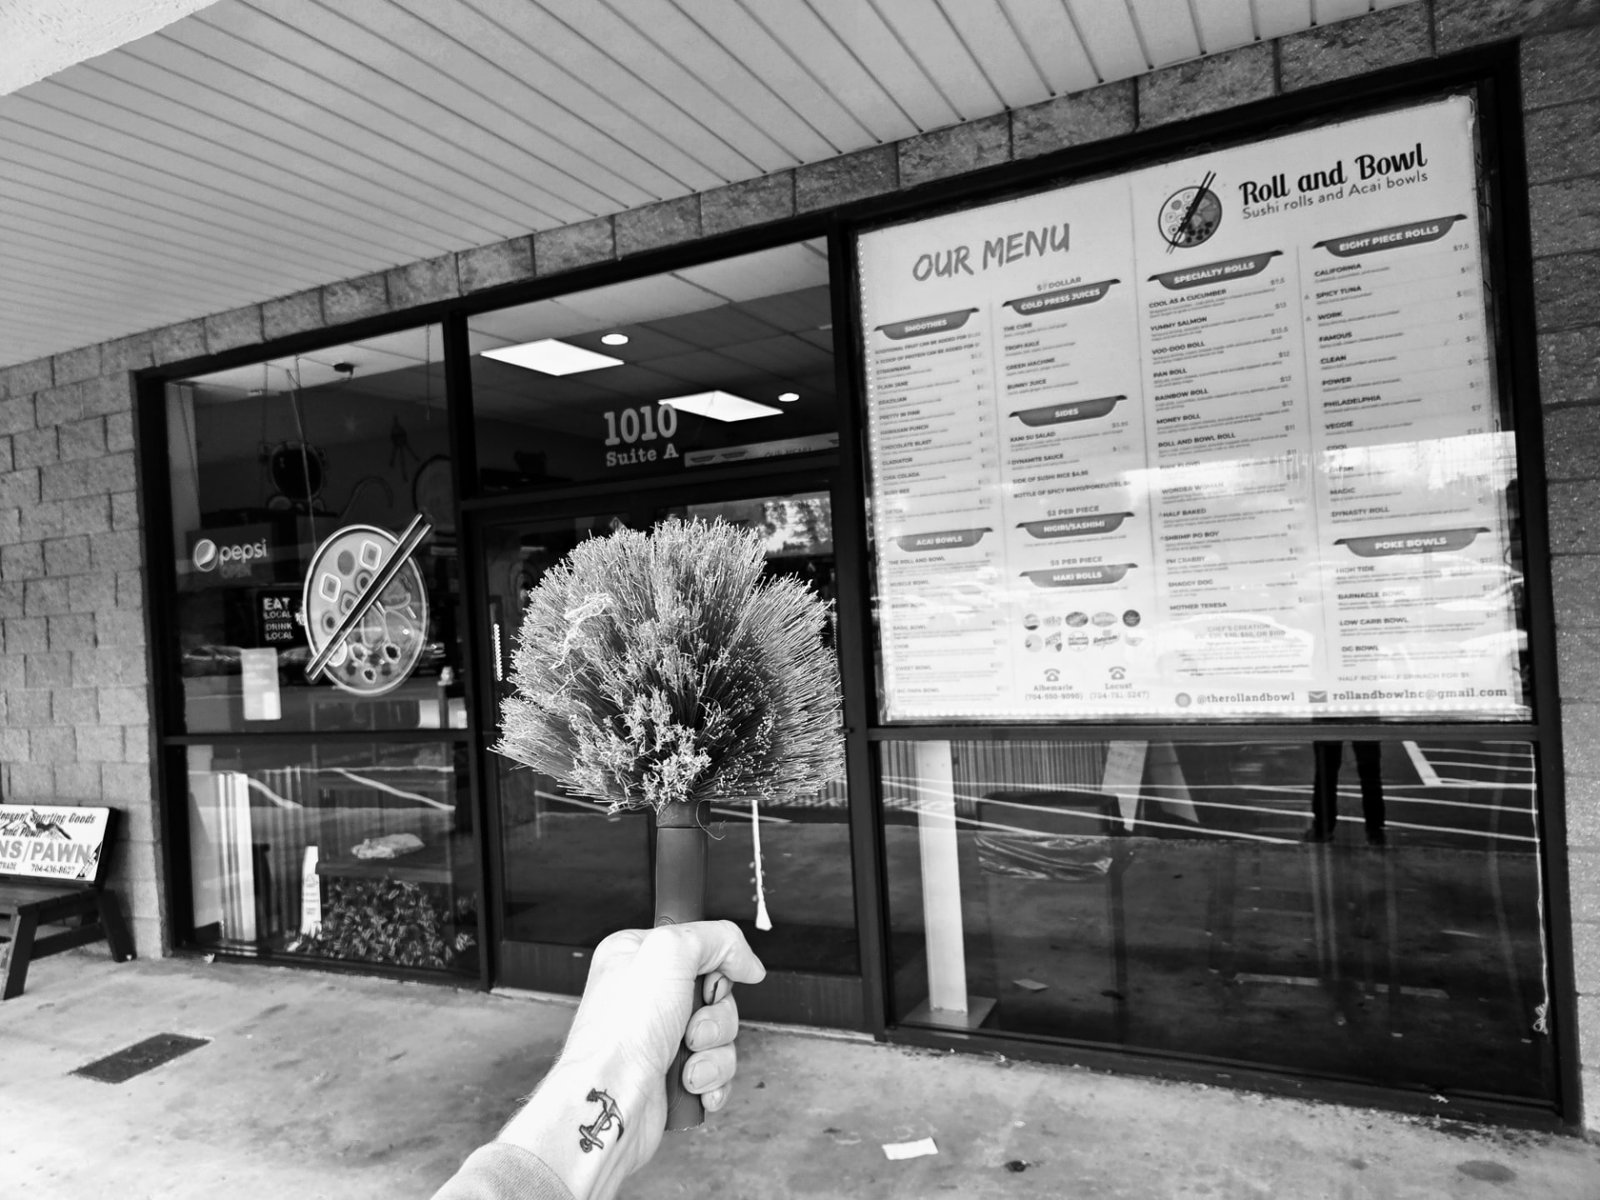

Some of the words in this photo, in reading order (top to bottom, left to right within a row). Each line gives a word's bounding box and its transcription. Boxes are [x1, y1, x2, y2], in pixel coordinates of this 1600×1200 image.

[1238, 173, 1291, 206] Roll
[1297, 160, 1348, 193] and
[1355, 142, 1428, 181] Bowl
[1242, 201, 1279, 219] Sushi
[1284, 195, 1313, 213] rolls
[1318, 188, 1344, 204] and
[1348, 180, 1382, 197] Acai
[1387, 170, 1428, 190] bowls
[1339, 239, 1370, 252] EIGHT
[1372, 232, 1403, 245] PIECE
[1405, 225, 1439, 239] ROLLS
[912, 246, 974, 282] OUR
[983, 223, 1070, 270] MENU
[1174, 267, 1223, 284] SPECIALTY
[1224, 261, 1255, 275] ROLLS
[1314, 263, 1362, 277] CALIFORNIA
[1048, 276, 1081, 290] DOLLAR
[1149, 301, 1168, 309] COOL
[1186, 288, 1227, 301] CUCUMBER
[1315, 290, 1338, 299] SPICY
[1340, 285, 1362, 295] TUNA
[1021, 300, 1043, 311] COLD
[1044, 294, 1071, 306] PRESS
[1071, 288, 1101, 301] JUICES
[905, 319, 947, 333] SMOOTHIES
[1150, 322, 1176, 332] YUMMY
[1177, 316, 1207, 327] SALMON
[1319, 332, 1352, 343] FAMOUS
[1187, 341, 1205, 350] ROLL
[1006, 362, 1026, 371] GREEN
[1027, 357, 1055, 367] MACHINE
[1320, 355, 1347, 365] CLEAN
[1169, 368, 1188, 376] ROLL
[1029, 378, 1047, 387] JUICE
[1322, 377, 1352, 386] POWER
[1155, 391, 1189, 401] RAINBOW
[1190, 388, 1208, 396] ROLL
[1323, 395, 1381, 408] PHILADELPHIA
[1055, 408, 1079, 418] SIDES
[1156, 416, 1181, 425] MONEY
[1183, 413, 1200, 421] ROLL
[604, 403, 678, 446] 1010
[1035, 431, 1056, 440] SALAD
[1158, 440, 1176, 448] ROLL
[1194, 434, 1216, 443] BOWL
[1217, 432, 1236, 440] ROLL
[606, 448, 657, 467] Suite
[663, 443, 679, 460] A
[1043, 453, 1063, 462] SAUCE
[1047, 487, 1065, 495] SPICY
[1075, 505, 1100, 514] PIECE
[1163, 510, 1180, 518] HALF
[1182, 507, 1207, 516] BAKED
[1331, 508, 1367, 518] DYNASTY
[1369, 506, 1390, 514] ROLL
[935, 535, 963, 545] BOWLS
[1204, 530, 1220, 538] BOY
[1375, 540, 1405, 551] POKE
[1406, 536, 1447, 548] BOWLS
[219, 538, 267, 566] pepsi
[1079, 555, 1102, 564] PIECE
[1076, 571, 1102, 580] ROLLS
[1338, 591, 1380, 600] BARNACLE
[263, 597, 291, 611] EAT
[263, 610, 293, 620] LOCAL
[1384, 616, 1409, 624] BOWL
[265, 622, 293, 631] DRINK
[265, 631, 294, 641] LOCAL
[1196, 691, 1295, 705] @therollandbowl
[1333, 687, 1508, 702] rollandbowlnc@gmail.com
[68, 812, 97, 825] Goods
